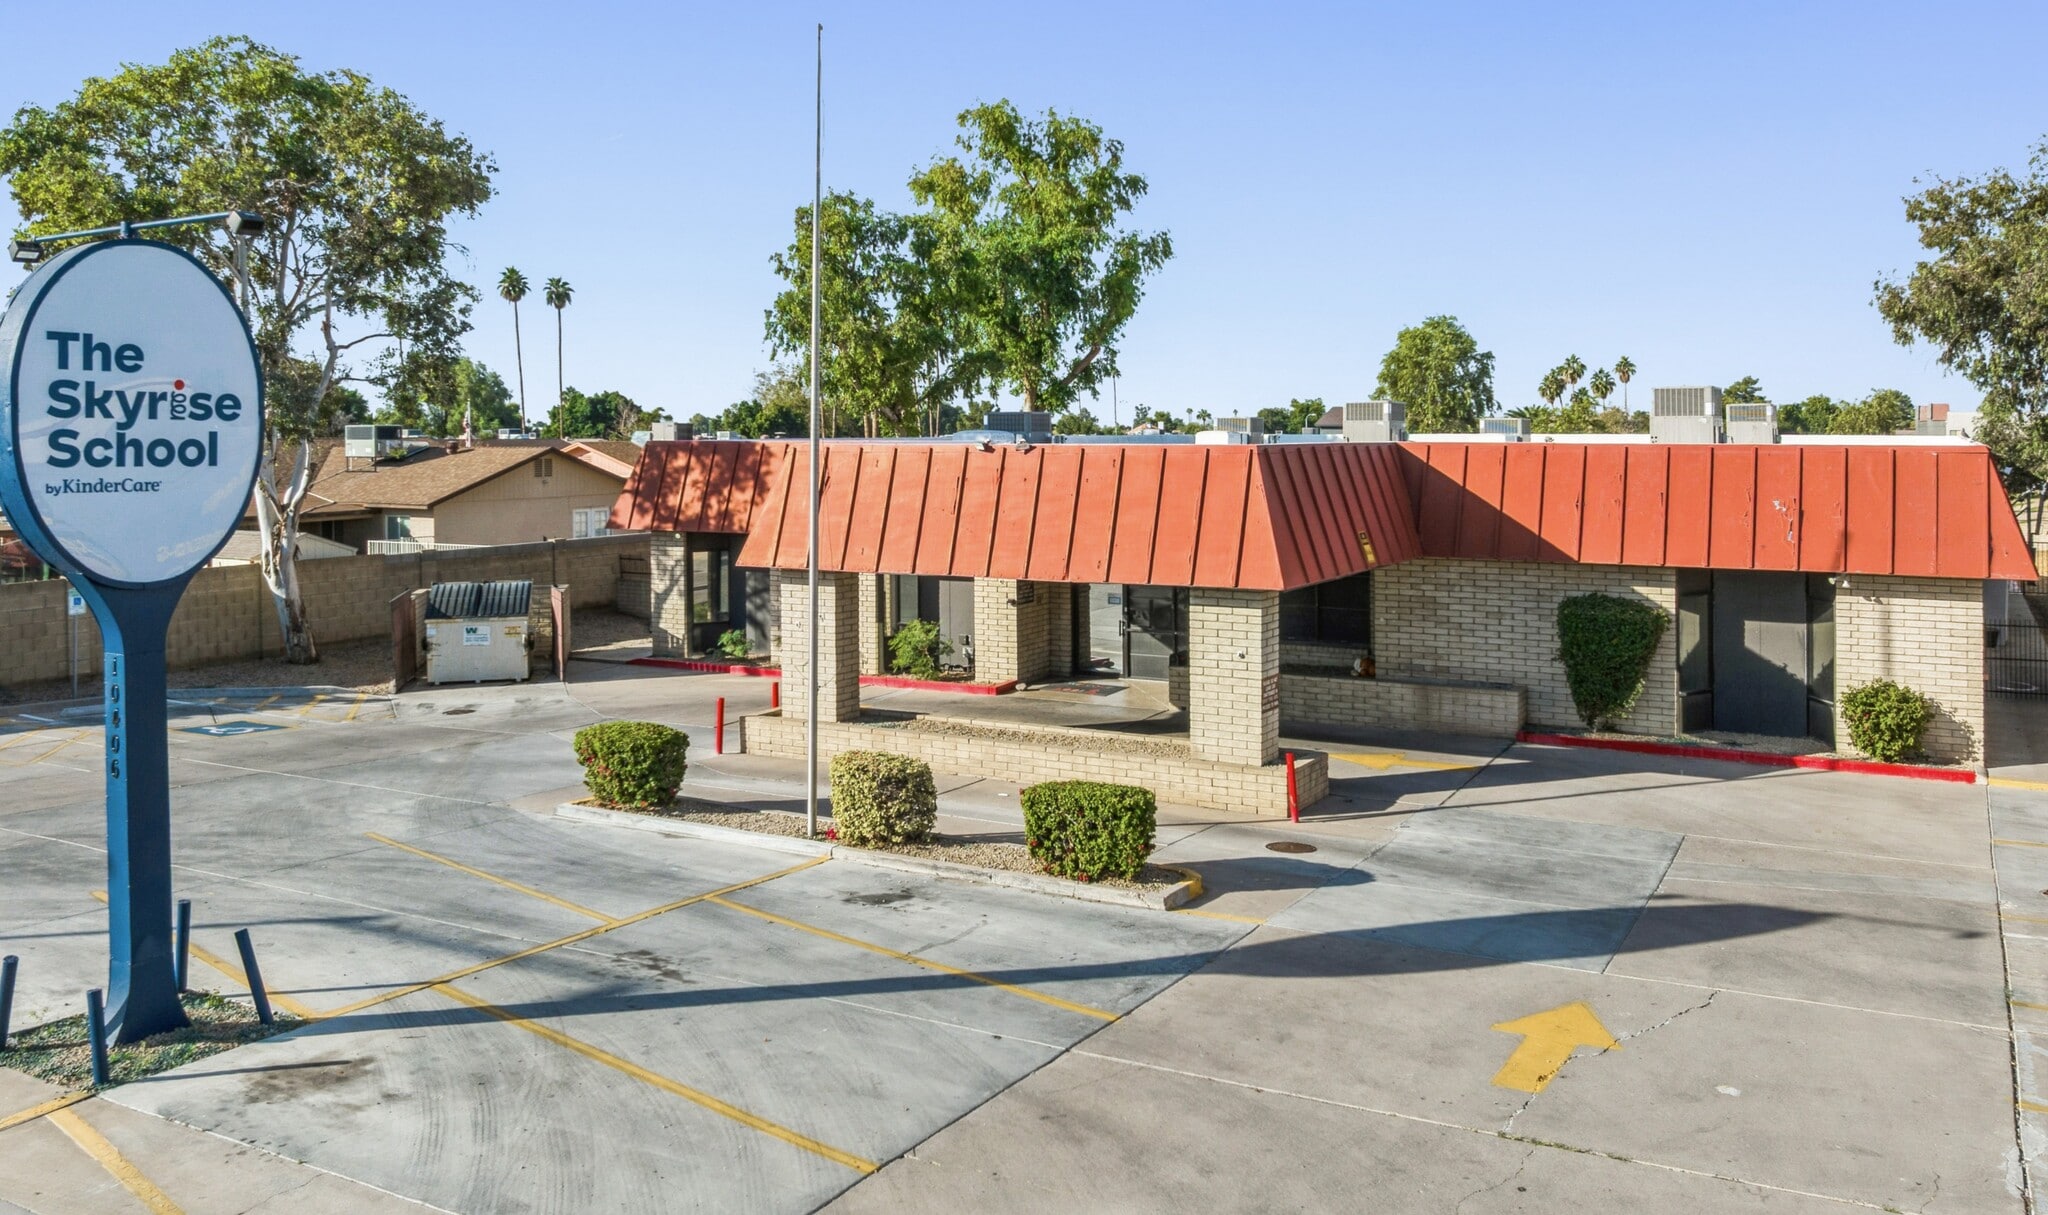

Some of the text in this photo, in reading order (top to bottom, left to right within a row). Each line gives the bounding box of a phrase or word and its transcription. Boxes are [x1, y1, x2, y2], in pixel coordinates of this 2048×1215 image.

[46, 331, 144, 373] The
[46, 379, 242, 431] Skyrise
[46, 428, 218, 468] School
